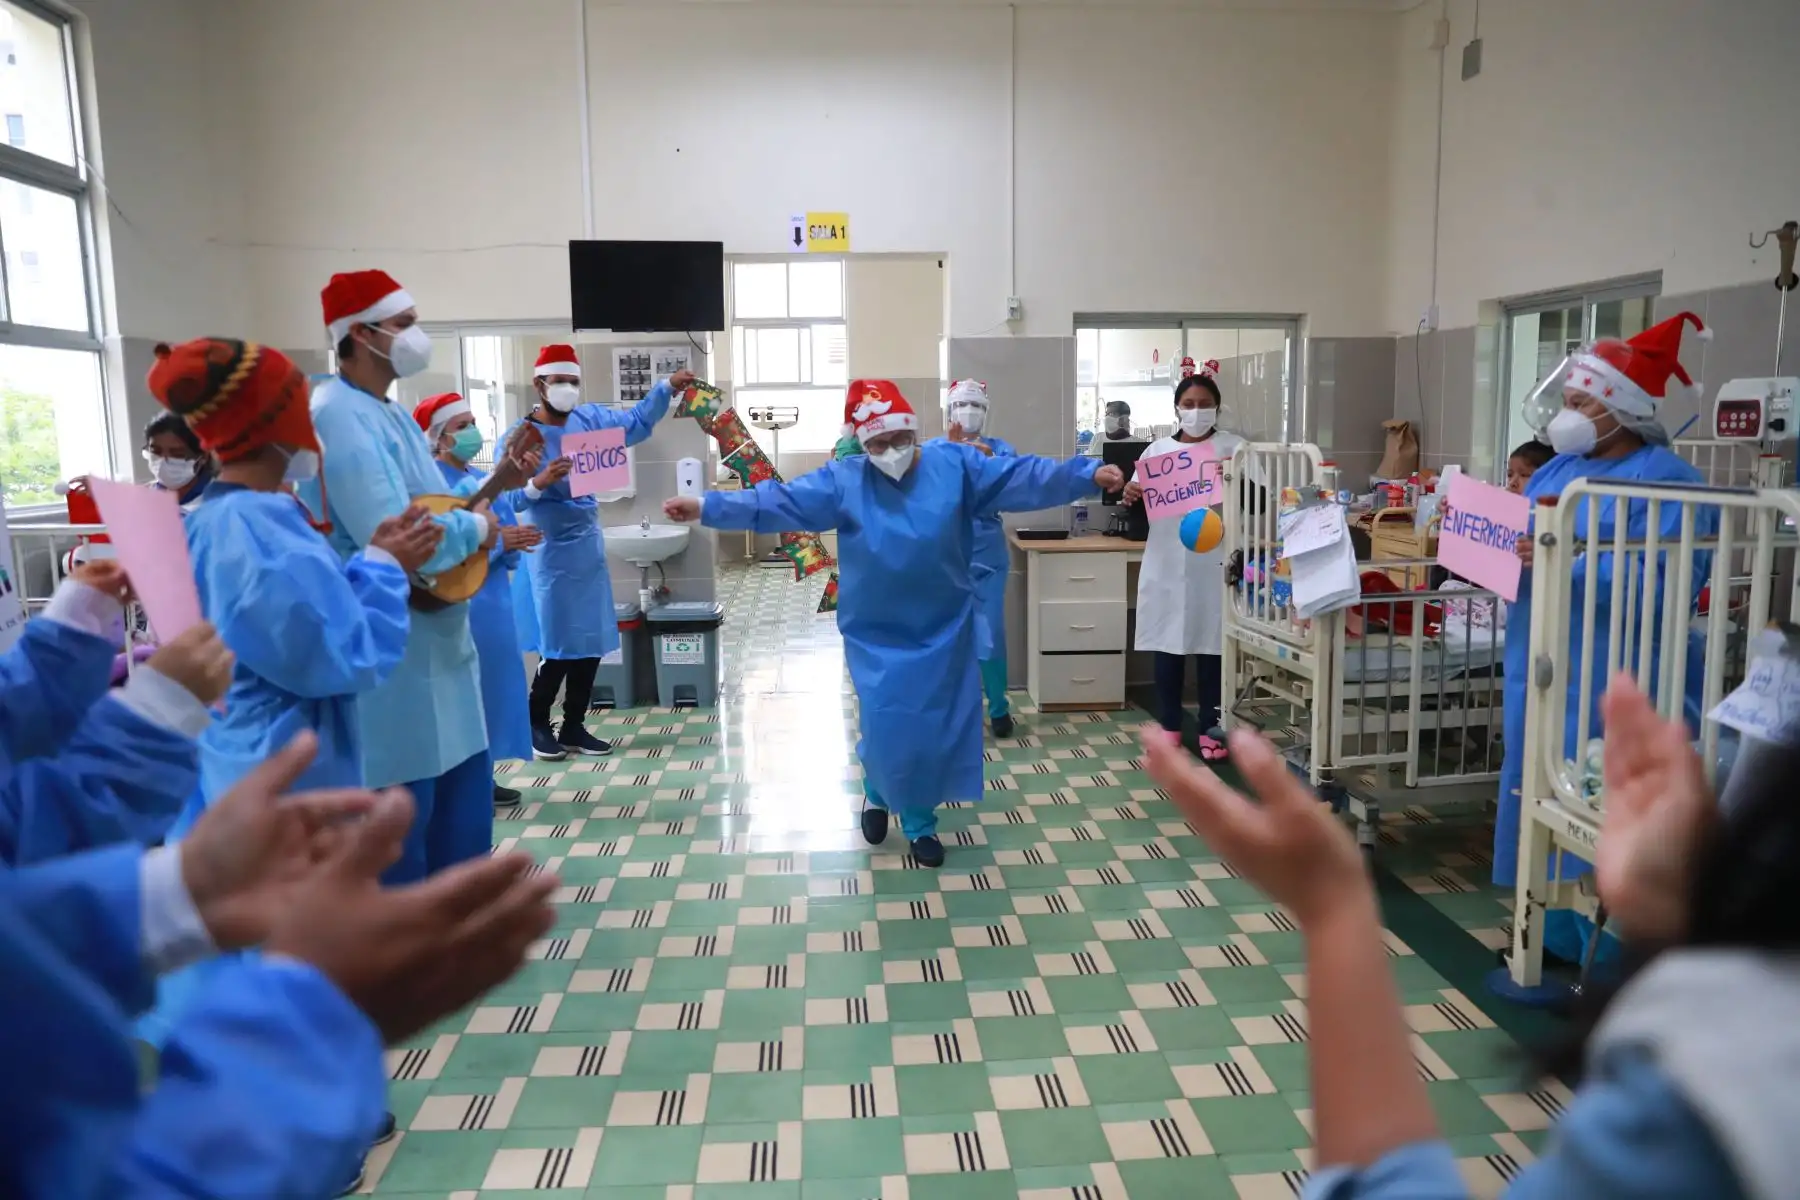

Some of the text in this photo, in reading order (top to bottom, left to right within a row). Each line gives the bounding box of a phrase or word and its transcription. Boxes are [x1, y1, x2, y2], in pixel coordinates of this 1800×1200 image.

[809, 224, 845, 240] SALA 1
[1145, 451, 1193, 479] LOS
[1143, 479, 1213, 509] PACIENTES
